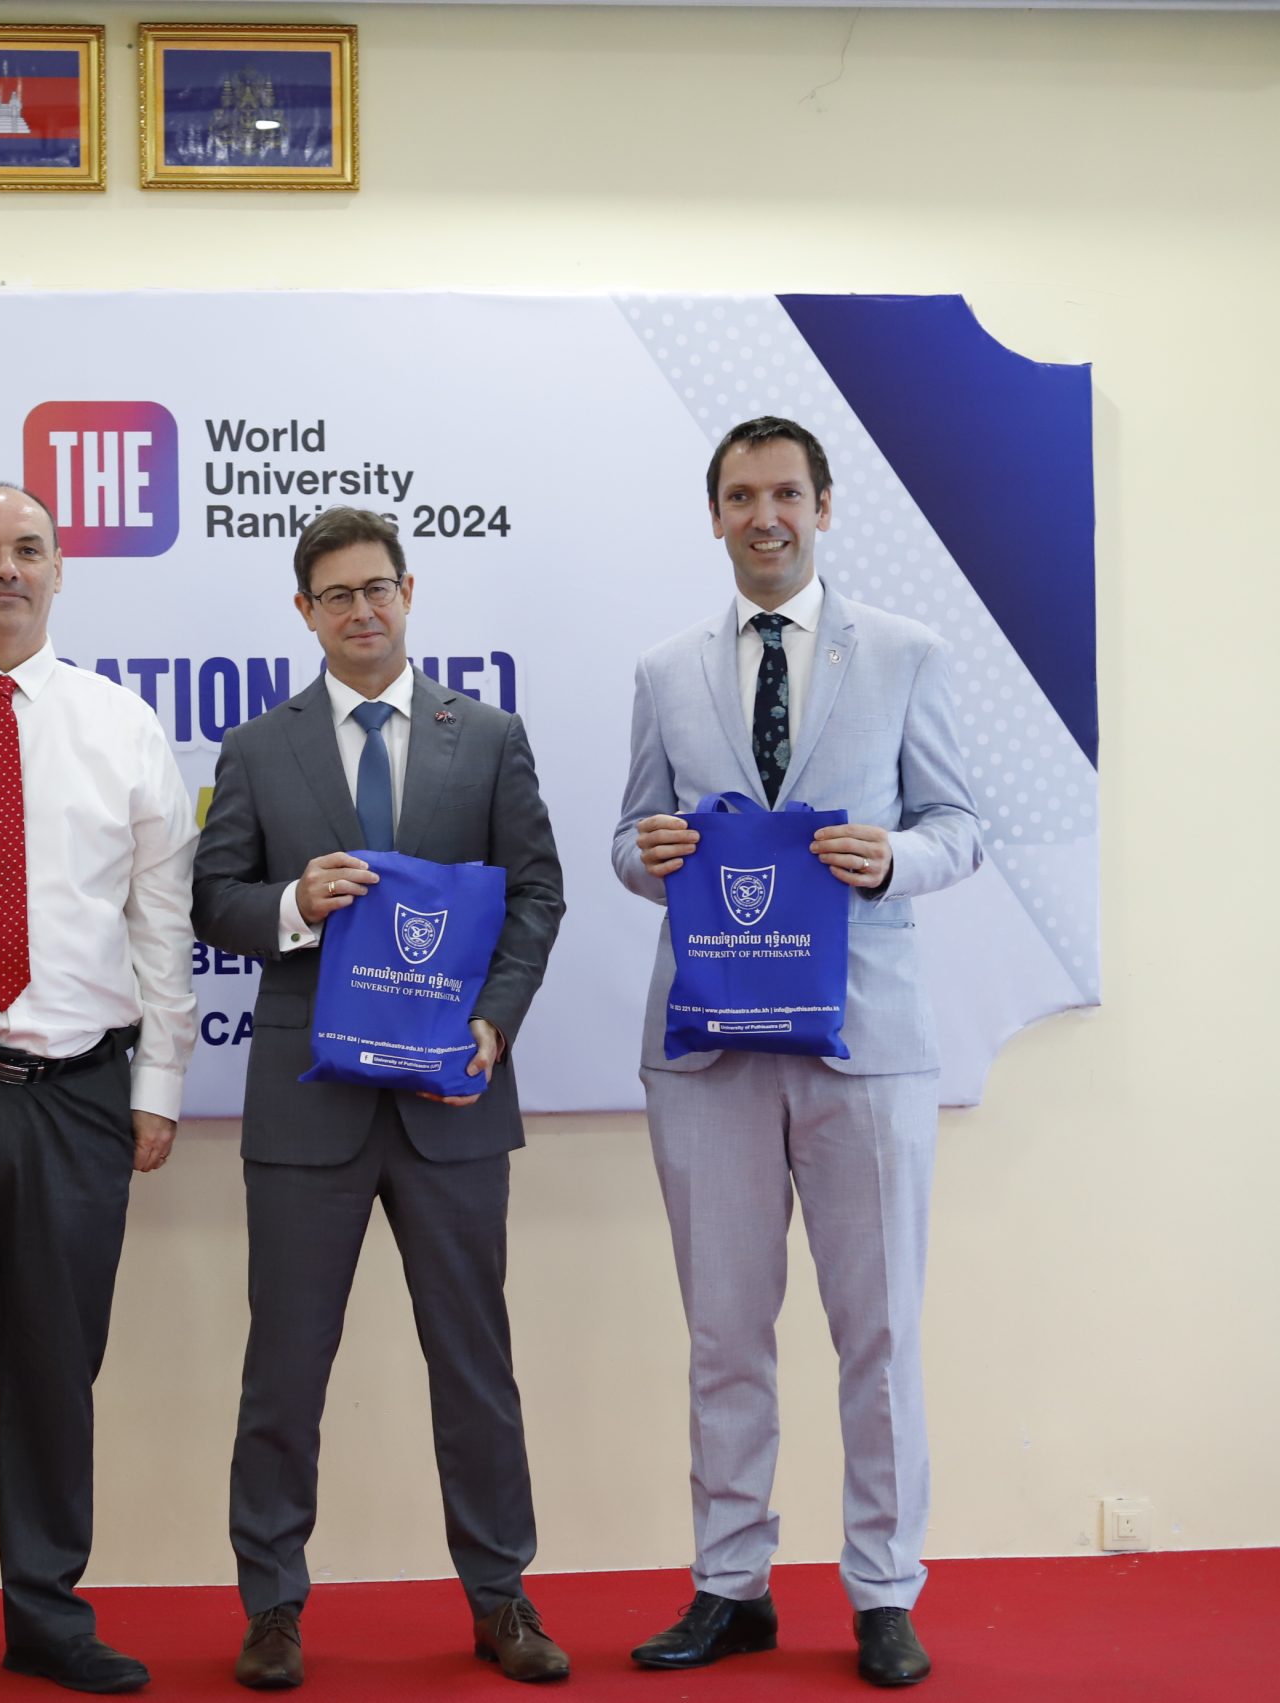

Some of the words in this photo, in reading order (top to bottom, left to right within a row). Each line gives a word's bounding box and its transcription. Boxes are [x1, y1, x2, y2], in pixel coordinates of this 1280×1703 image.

[205, 419, 326, 452] World
[49, 431, 153, 527] THE
[205, 462, 414, 502] University
[206, 505, 400, 538] Ranks
[413, 505, 511, 538] 2024
[688, 949, 737, 958] UNIVERSITY
[739, 950, 750, 958] OF
[752, 949, 811, 958] PUTHISASTRA
[351, 980, 401, 994] UNIVERSITY
[403, 987, 414, 996] OF
